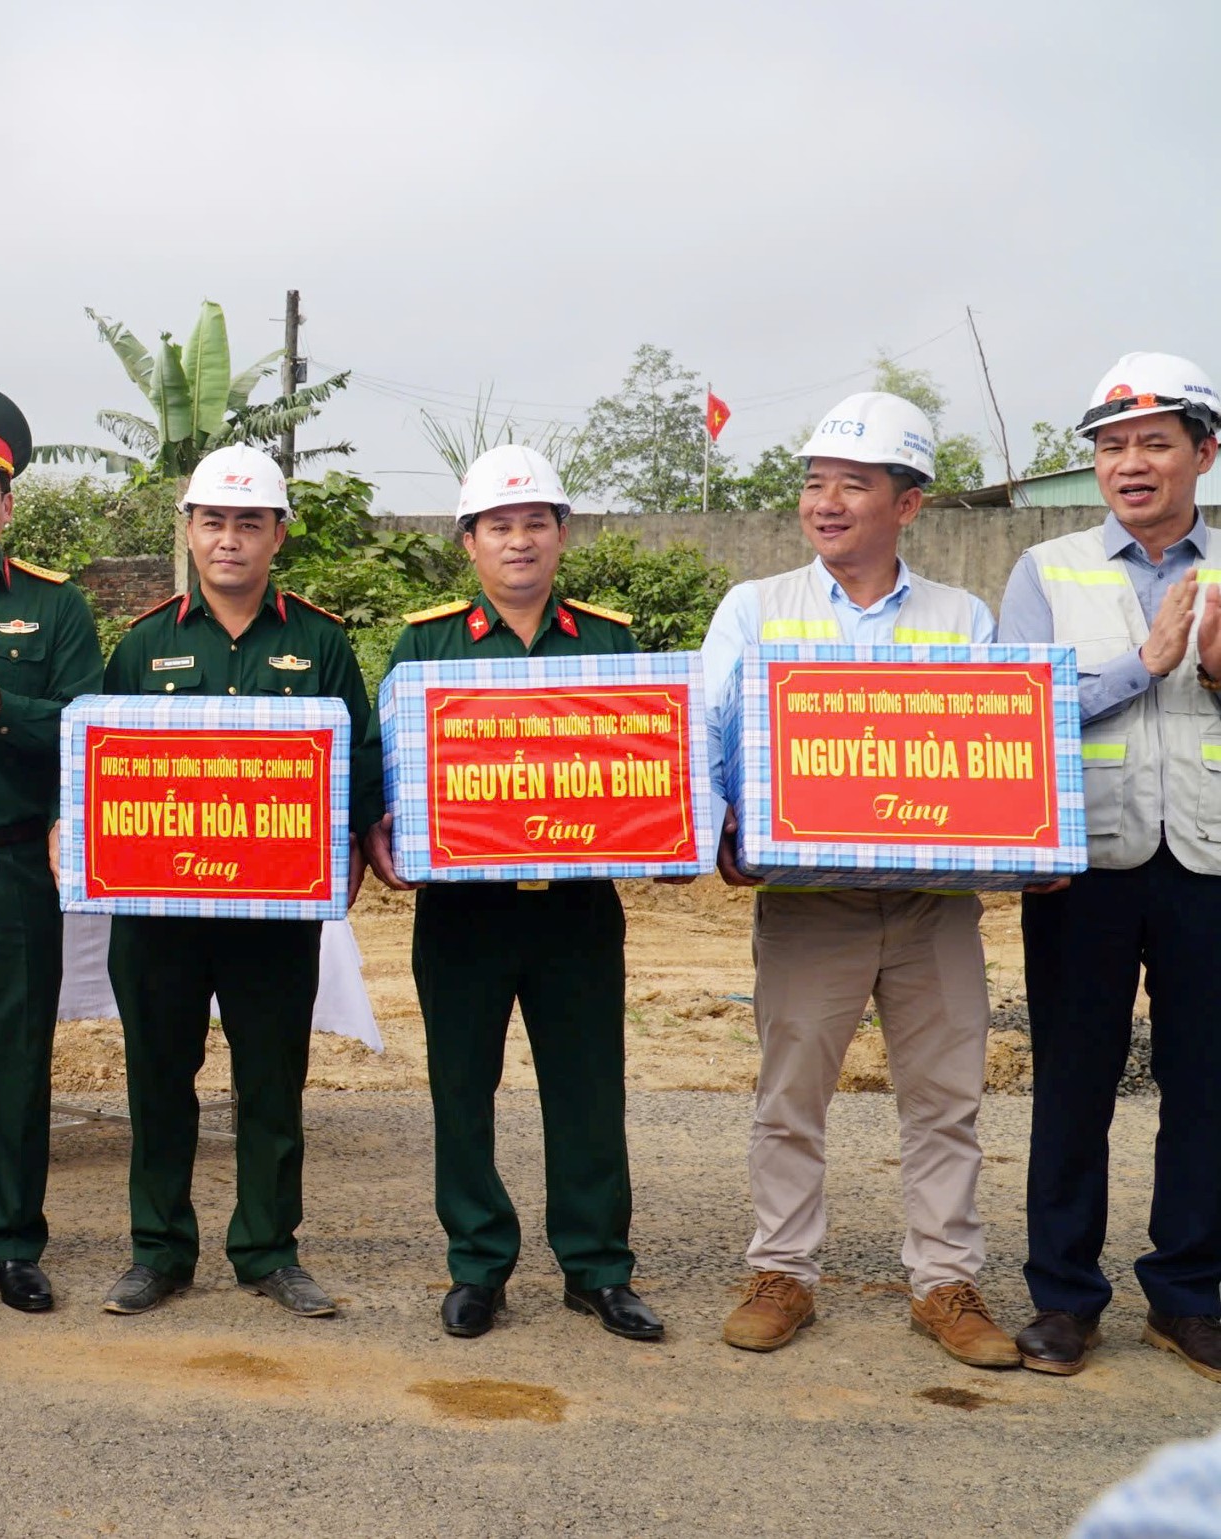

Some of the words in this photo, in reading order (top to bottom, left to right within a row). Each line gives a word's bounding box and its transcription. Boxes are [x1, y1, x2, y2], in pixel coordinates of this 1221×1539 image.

[788, 693, 821, 715] UVBCT,
[824, 689, 844, 712] PHÓ
[846, 686, 866, 712] THỦ
[868, 690, 901, 713] TƯỚNG
[904, 688, 945, 714] THƯỜNG
[947, 692, 973, 718] TRỰC
[977, 690, 1008, 714] CHÍNH
[1011, 687, 1033, 714] PHỦ
[444, 718, 475, 740] UVBCT,
[477, 714, 496, 738] PHÓ
[498, 712, 516, 738] THỦ
[519, 714, 551, 737] TƯỚNG
[553, 711, 591, 736] THƯỜNG
[593, 713, 617, 739] TRỰC
[620, 711, 649, 734] CHÍNH
[651, 708, 671, 734] PHỦ
[101, 756, 130, 778] UVBCT,
[132, 754, 150, 776] PHÓ
[152, 752, 169, 777] THỦ
[171, 755, 200, 777] TƯỚNG
[203, 754, 238, 777] THƯỜNG
[240, 758, 263, 782] TRỰC
[265, 755, 293, 778] CHÍNH
[295, 753, 313, 778] PHỦ
[791, 726, 897, 777] NGUYỄN
[905, 731, 959, 779] HÒA
[967, 733, 1033, 780] BÌNH
[446, 750, 546, 801] NGUYỄN
[553, 753, 604, 799] HÒA
[611, 753, 671, 797] BÌNH
[102, 789, 194, 836] NGUYỄN
[202, 794, 248, 837] HÒA
[255, 796, 311, 838] BÌNH
[873, 794, 949, 826] Tặng
[524, 815, 596, 844] Tặng
[173, 852, 238, 881] Tặng
